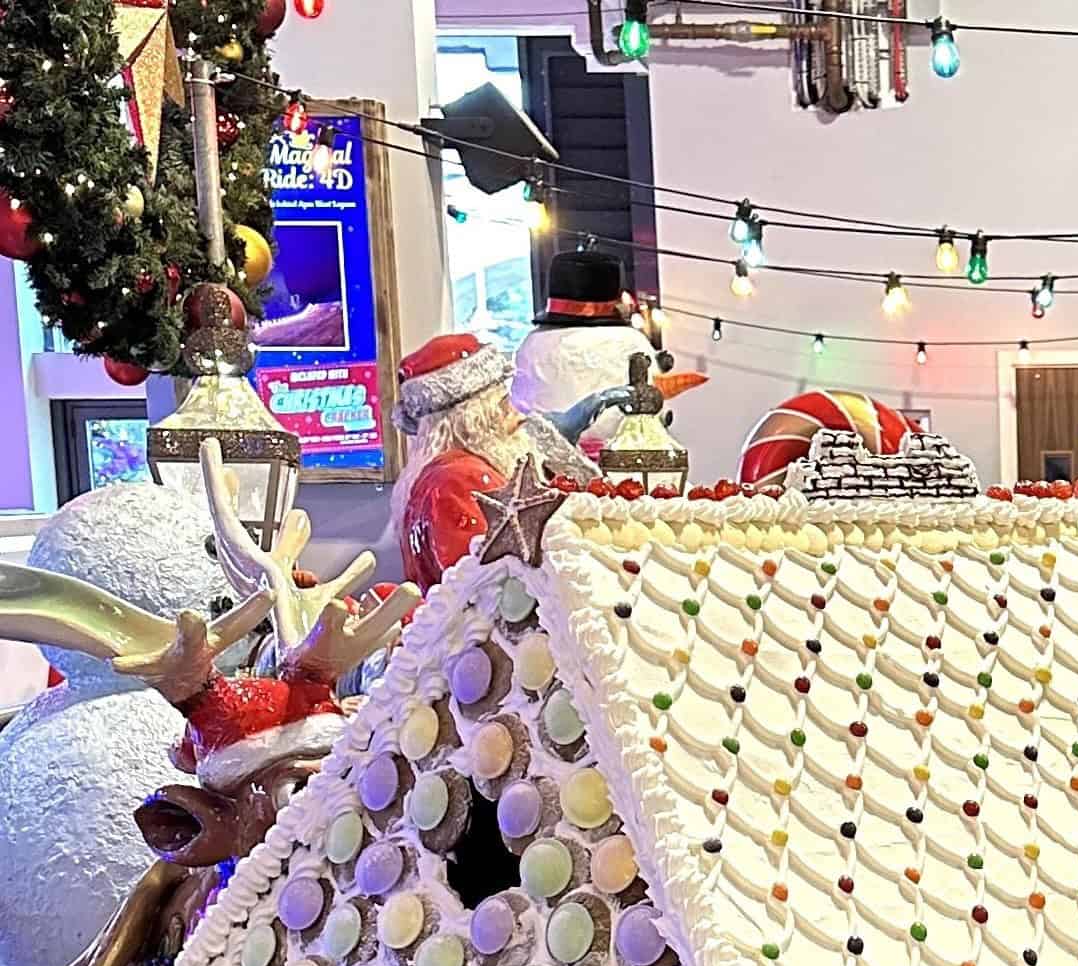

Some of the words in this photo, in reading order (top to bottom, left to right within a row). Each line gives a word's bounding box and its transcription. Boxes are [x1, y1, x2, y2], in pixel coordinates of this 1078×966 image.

[270, 141, 353, 173] Magal
[260, 166, 314, 190] Ride:
[319, 168, 353, 190] 4D
[271, 385, 365, 413] CHRISTMAS
